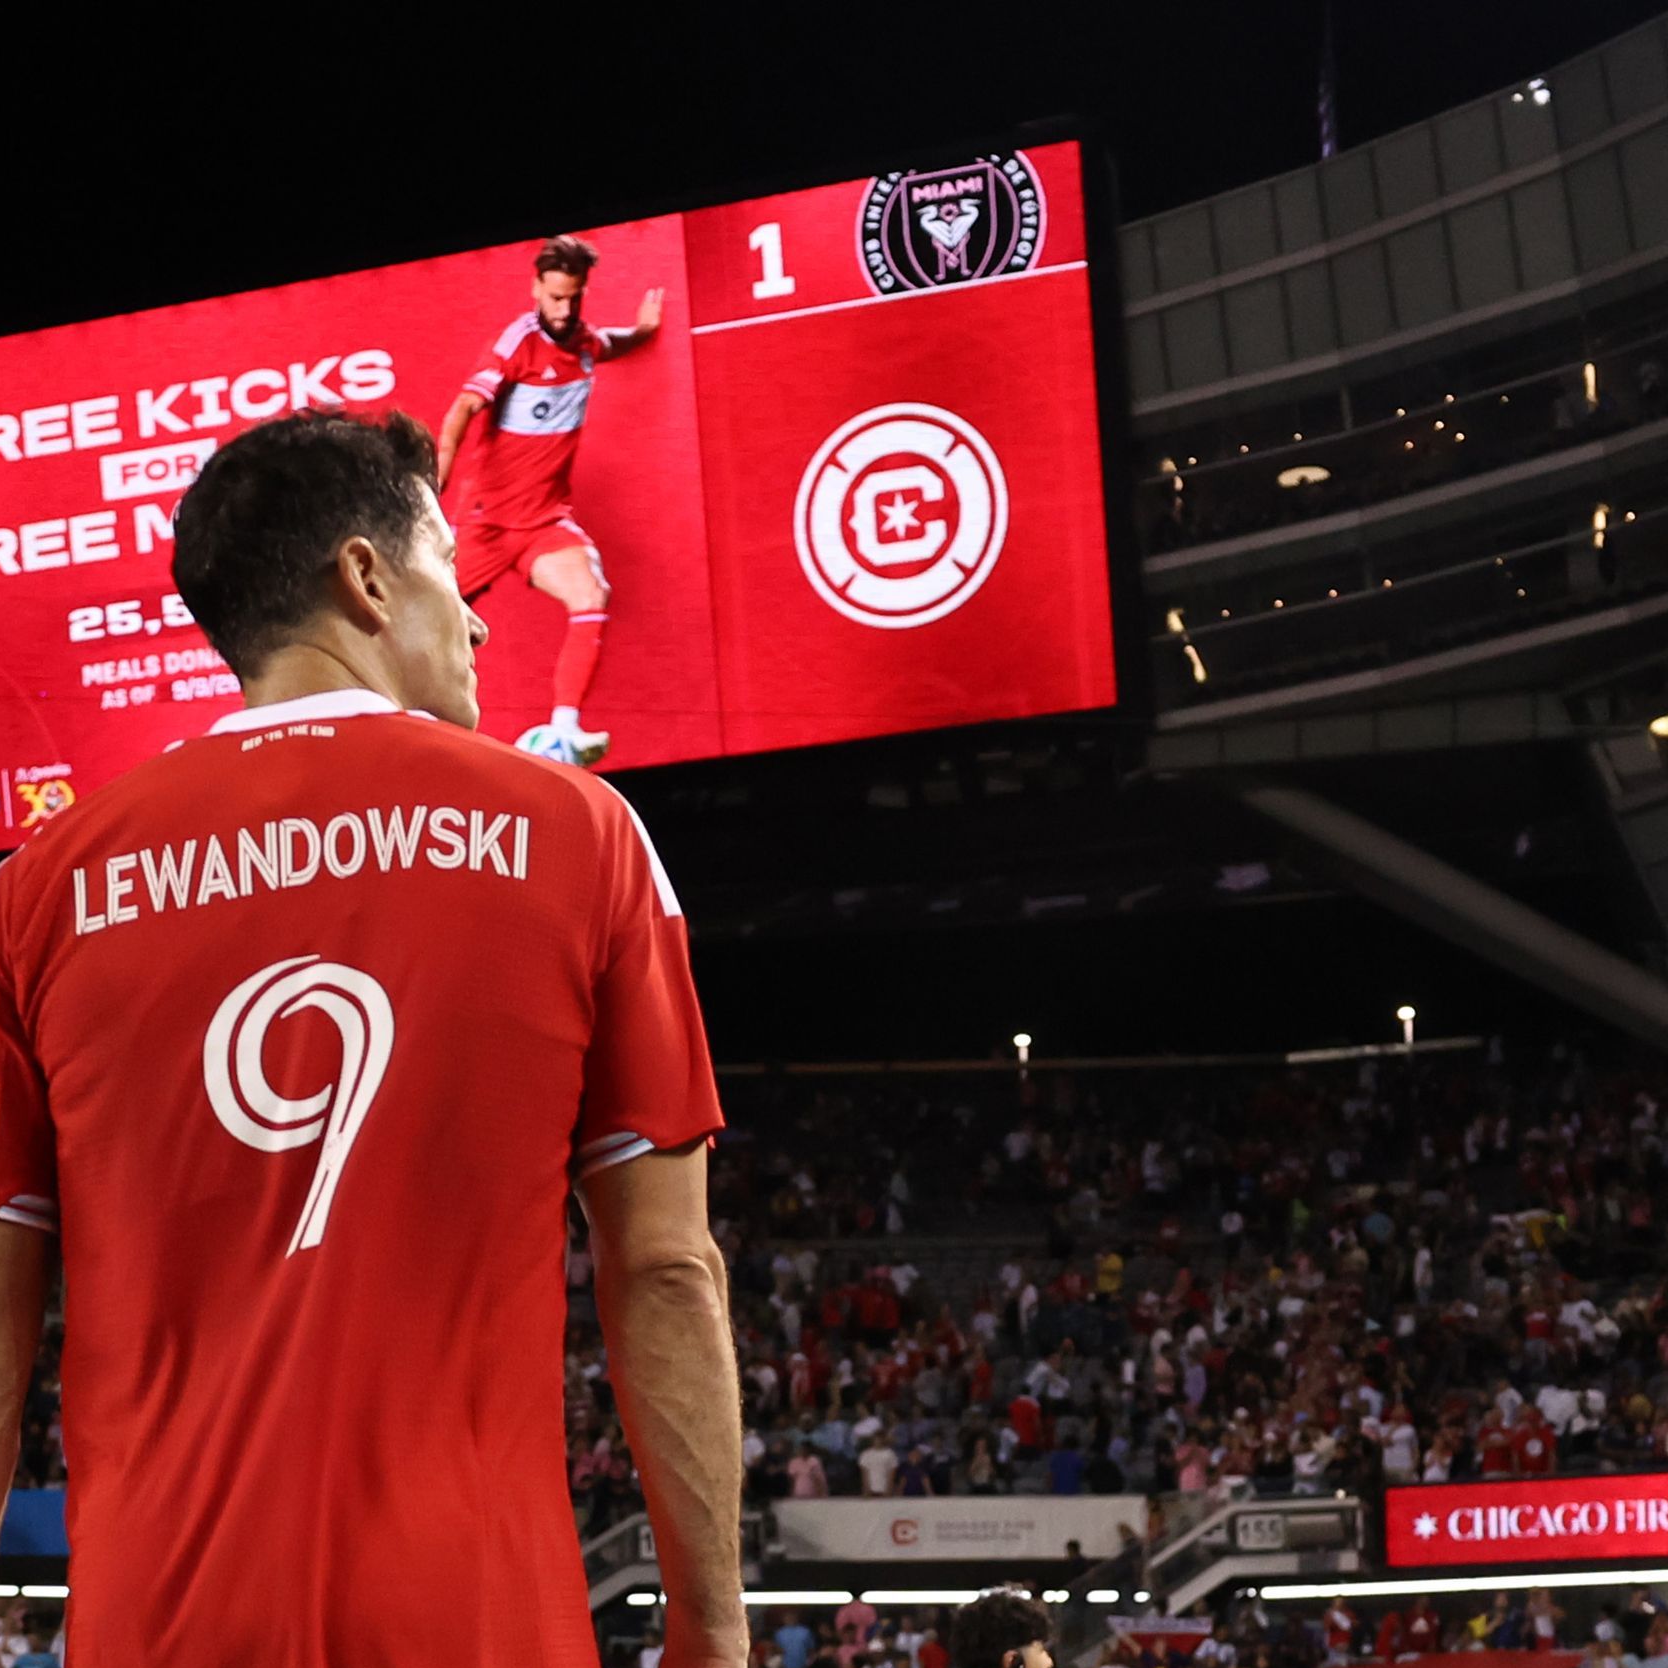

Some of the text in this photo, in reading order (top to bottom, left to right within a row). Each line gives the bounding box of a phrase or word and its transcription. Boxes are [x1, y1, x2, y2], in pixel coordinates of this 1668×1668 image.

[911, 175, 984, 204] MIAMI
[748, 222, 796, 301] 1
[135, 347, 398, 438] KICKS
[119, 452, 198, 487] FOR
[81, 655, 162, 688] MEALS
[100, 688, 130, 711] AS
[129, 684, 157, 706] OF
[73, 804, 530, 936] LEWANDOWSKI
[203, 953, 395, 1259] 9
[1447, 1501, 1609, 1542] CHICAGO
